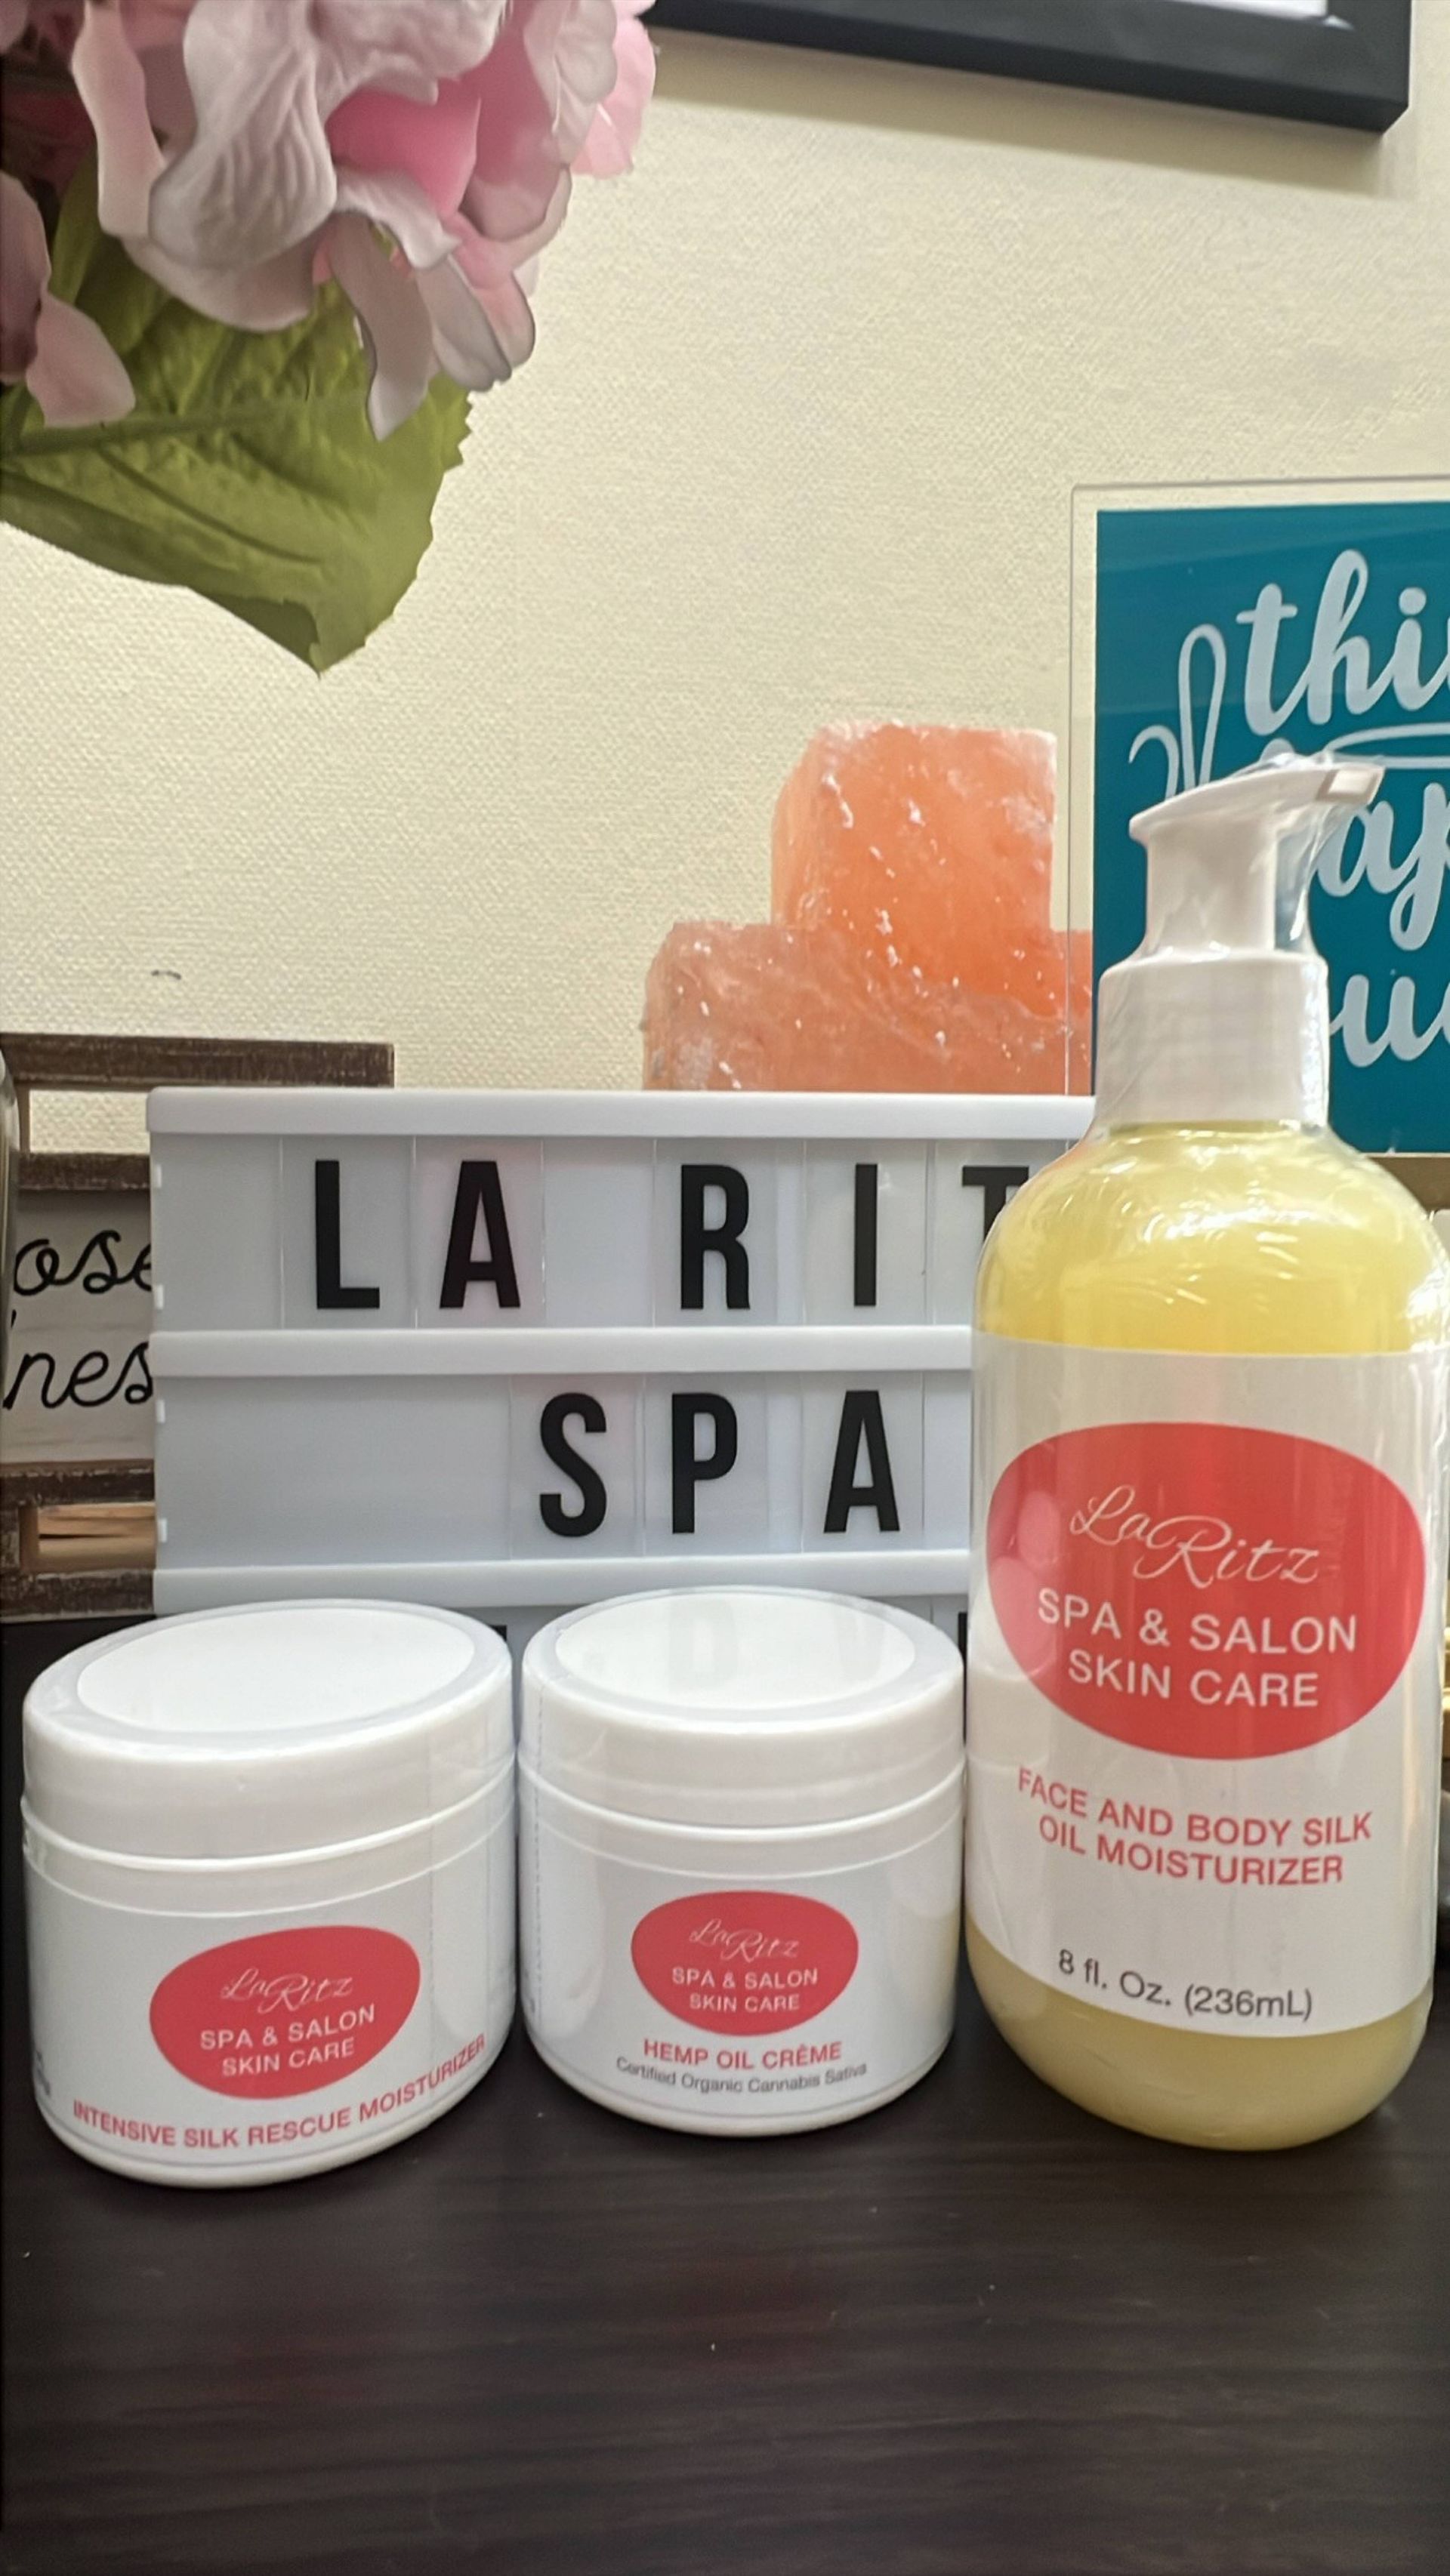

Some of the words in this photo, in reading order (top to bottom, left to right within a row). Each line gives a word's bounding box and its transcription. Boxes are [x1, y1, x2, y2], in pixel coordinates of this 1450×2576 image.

[1236, 549, 1450, 736] thi
[315, 1160, 521, 1308] LA
[539, 1390, 900, 1537] SPA
[1038, 1587, 1121, 1640] SPA
[1139, 1608, 1171, 1647] &
[1189, 1613, 1357, 1654] SALON
[1068, 1649, 1171, 1699] SKIN
[1190, 1669, 1319, 1707] CARE
[1018, 1766, 1088, 1819] FACE
[1098, 1798, 1174, 1836] AND
[1186, 1813, 1292, 1847] BODY
[1302, 1810, 1373, 1847] SILK
[1038, 1814, 1087, 1856] OIL
[1097, 1833, 1344, 1886] MOISTURIZER
[672, 1966, 716, 1988] SPA
[722, 1971, 736, 1989] &
[745, 1967, 819, 1990] SALON
[689, 1992, 738, 2013] SKIN
[745, 1993, 801, 2014] CARE
[1059, 1949, 1074, 1975] 8
[1084, 1958, 1108, 1990] fl.
[1119, 1971, 1171, 2006] Oz.
[1184, 1983, 1313, 2022] (236mL)
[199, 2029, 254, 2051] SPA
[262, 2026, 279, 2047] &
[288, 2002, 376, 2043] SALON
[222, 2053, 281, 2076] SKIN
[288, 2036, 356, 2069] CARE
[643, 2038, 709, 2066] HEMP
[716, 2050, 755, 2070] OIL
[73, 2099, 177, 2147] INTENSIVE
[183, 2127, 239, 2148] SILK
[248, 2107, 352, 2146] RESCUE
[358, 2033, 486, 2123] MOISTURIZER
[615, 2056, 677, 2087] Certified
[680, 2071, 744, 2094] Organic
[747, 2075, 822, 2094] Cannabis
[825, 2063, 868, 2086] Sativa
